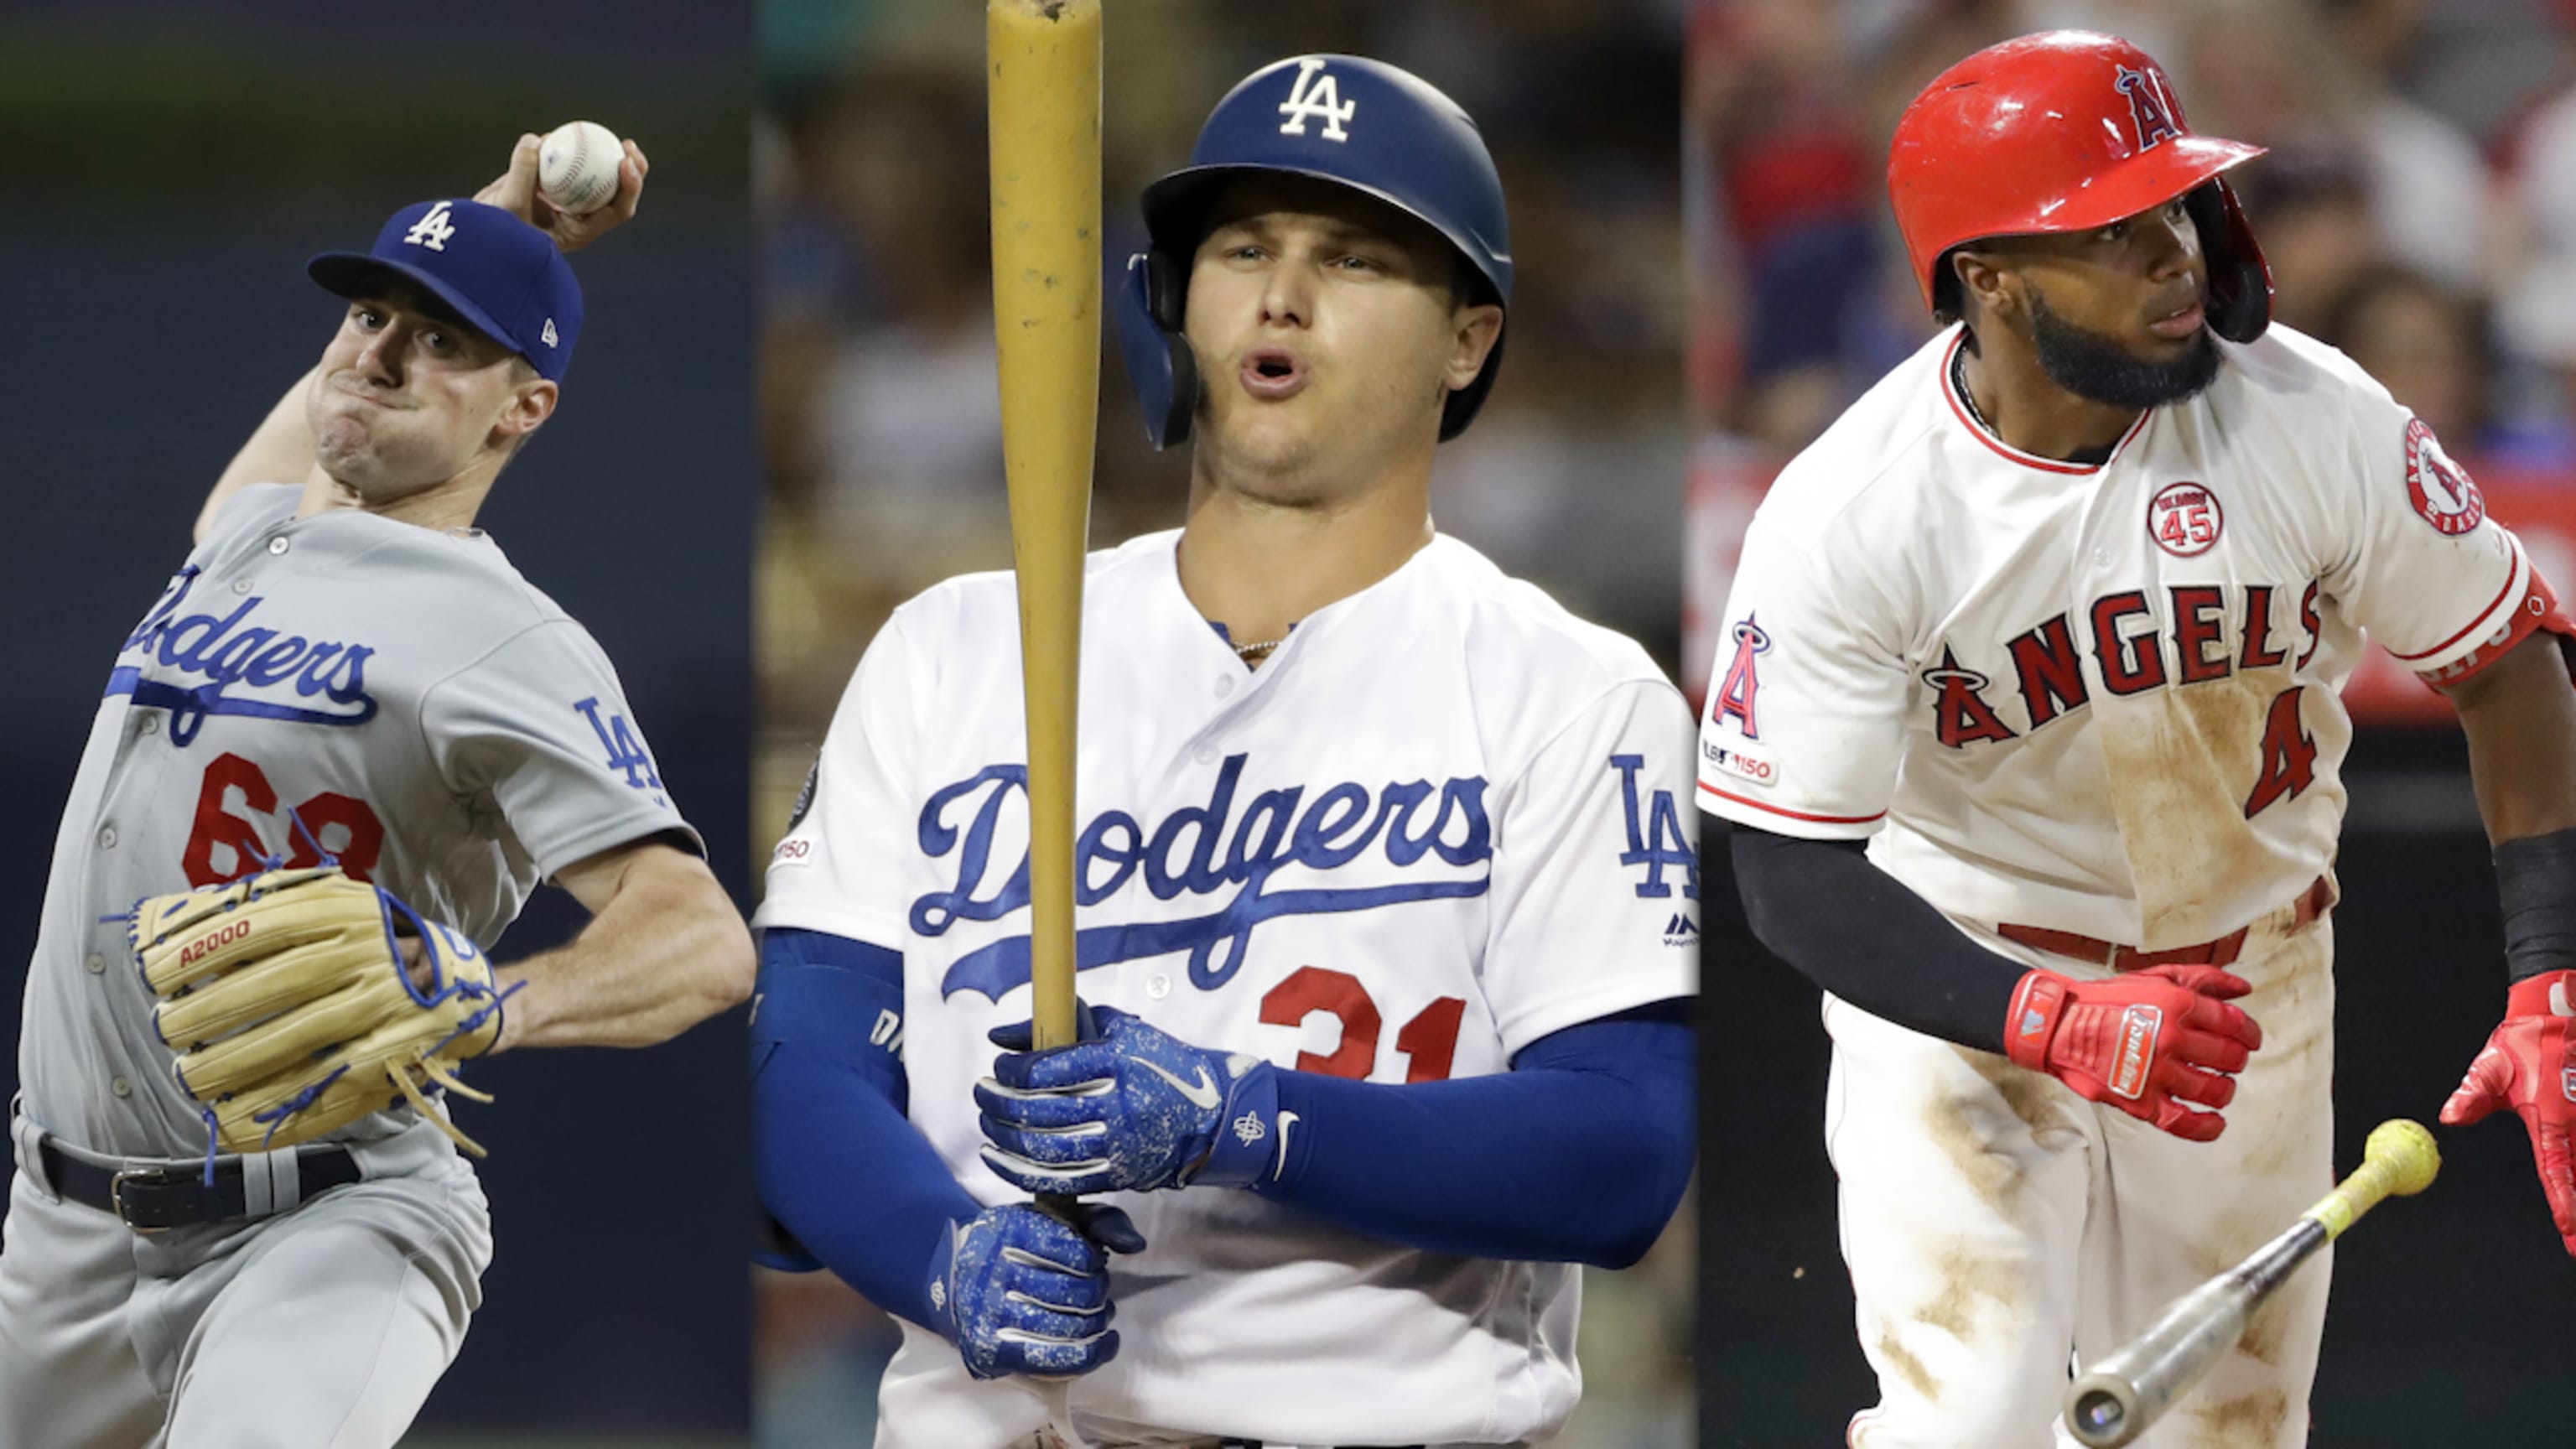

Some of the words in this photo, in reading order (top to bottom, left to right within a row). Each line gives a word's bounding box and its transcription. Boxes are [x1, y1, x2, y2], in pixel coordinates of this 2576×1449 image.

[1278, 59, 1356, 143] LA
[403, 200, 456, 252] LA
[2161, 506, 2213, 546] 45
[1711, 610, 1771, 741] A
[1921, 579, 2321, 749] ANGELS
[573, 696, 662, 789] LA
[2245, 685, 2317, 819] 4
[182, 751, 386, 891] 68
[909, 751, 1493, 1003] Dodgers
[1609, 754, 1701, 901] LA
[179, 919, 251, 969] A2000
[1259, 965, 1467, 1084] 31
